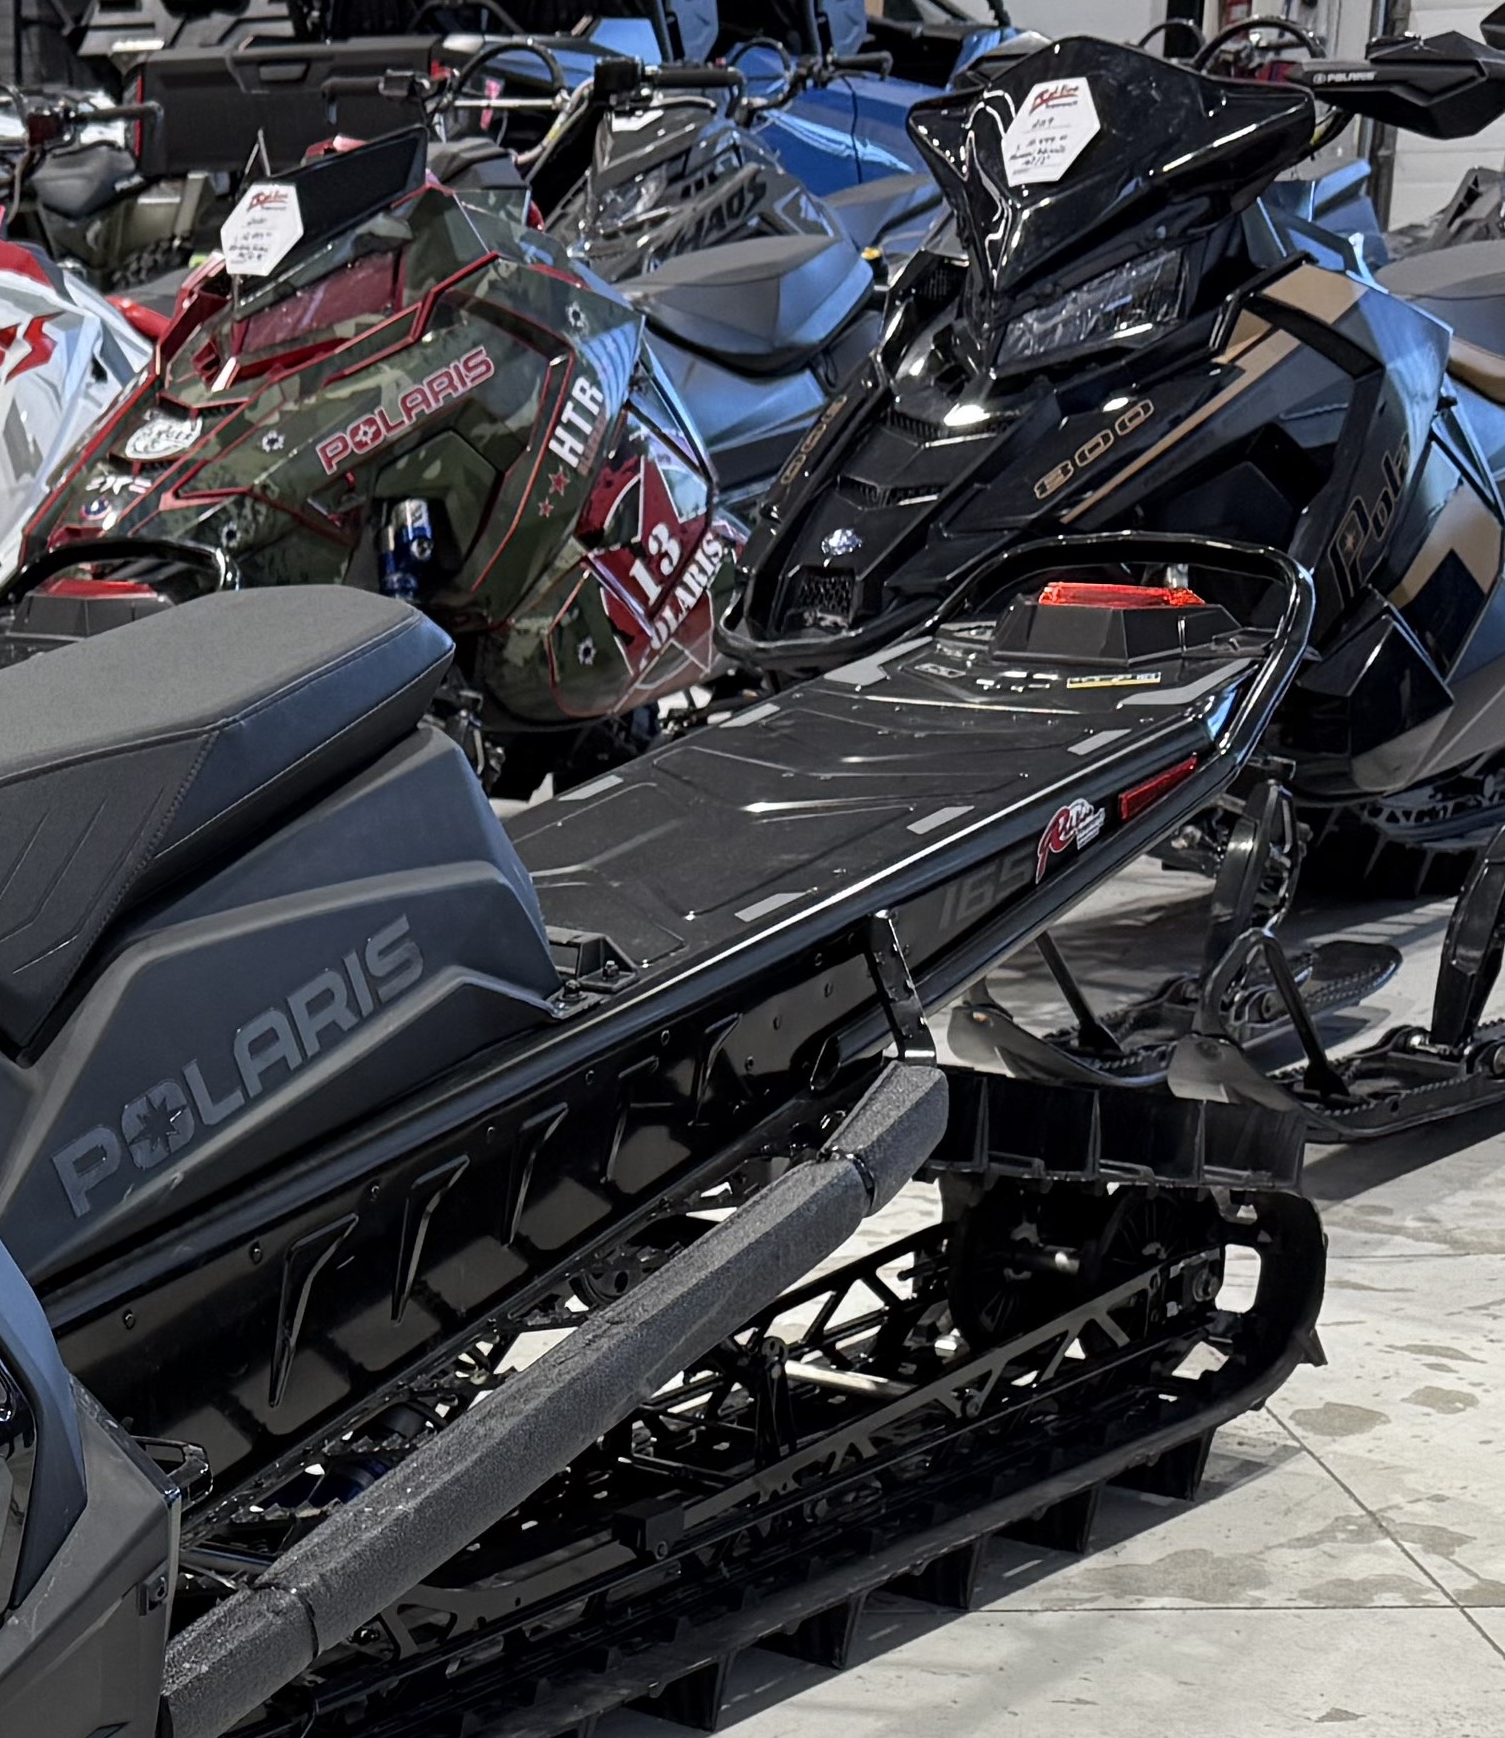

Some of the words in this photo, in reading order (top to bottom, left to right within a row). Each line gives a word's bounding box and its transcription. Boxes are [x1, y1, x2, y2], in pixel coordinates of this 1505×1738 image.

[316, 346, 495, 475] POLARIS
[548, 376, 604, 469] HTR
[1034, 399, 1155, 500] 800
[628, 521, 682, 605] 13
[938, 841, 1037, 931] 165
[52, 914, 425, 1218] POLARIS
